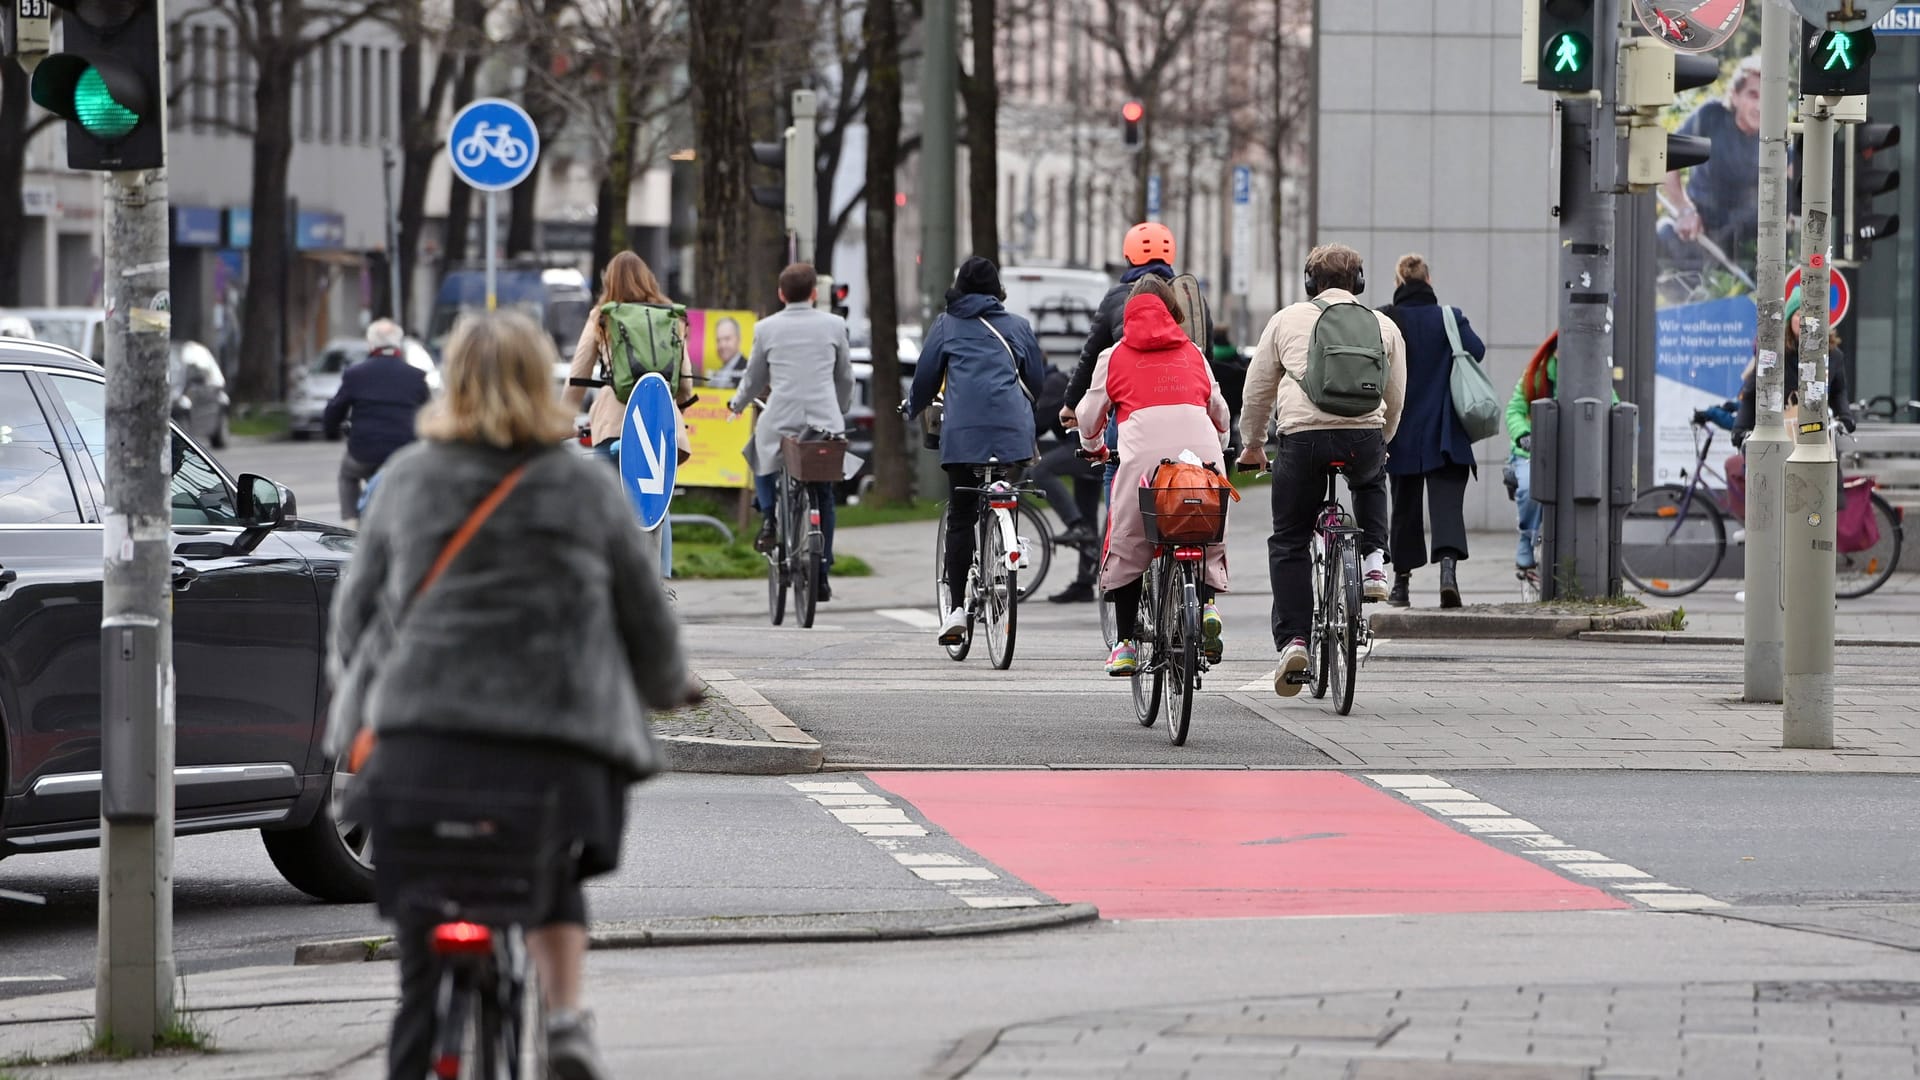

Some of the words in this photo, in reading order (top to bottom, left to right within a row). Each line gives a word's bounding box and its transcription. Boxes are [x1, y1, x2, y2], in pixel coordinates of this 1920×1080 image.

[22, 0, 47, 16] 551
[1659, 321, 1680, 332] Wir
[1682, 321, 1721, 332] wollen
[1723, 321, 1743, 332] mit
[1660, 336, 1679, 346] der
[1680, 336, 1716, 346] Natur
[1718, 336, 1750, 346] leben
[1659, 353, 1689, 364] Nicht
[1692, 355, 1729, 368] gegen
[1157, 376, 1180, 384] LONG
[1170, 384, 1189, 392] RAIN
